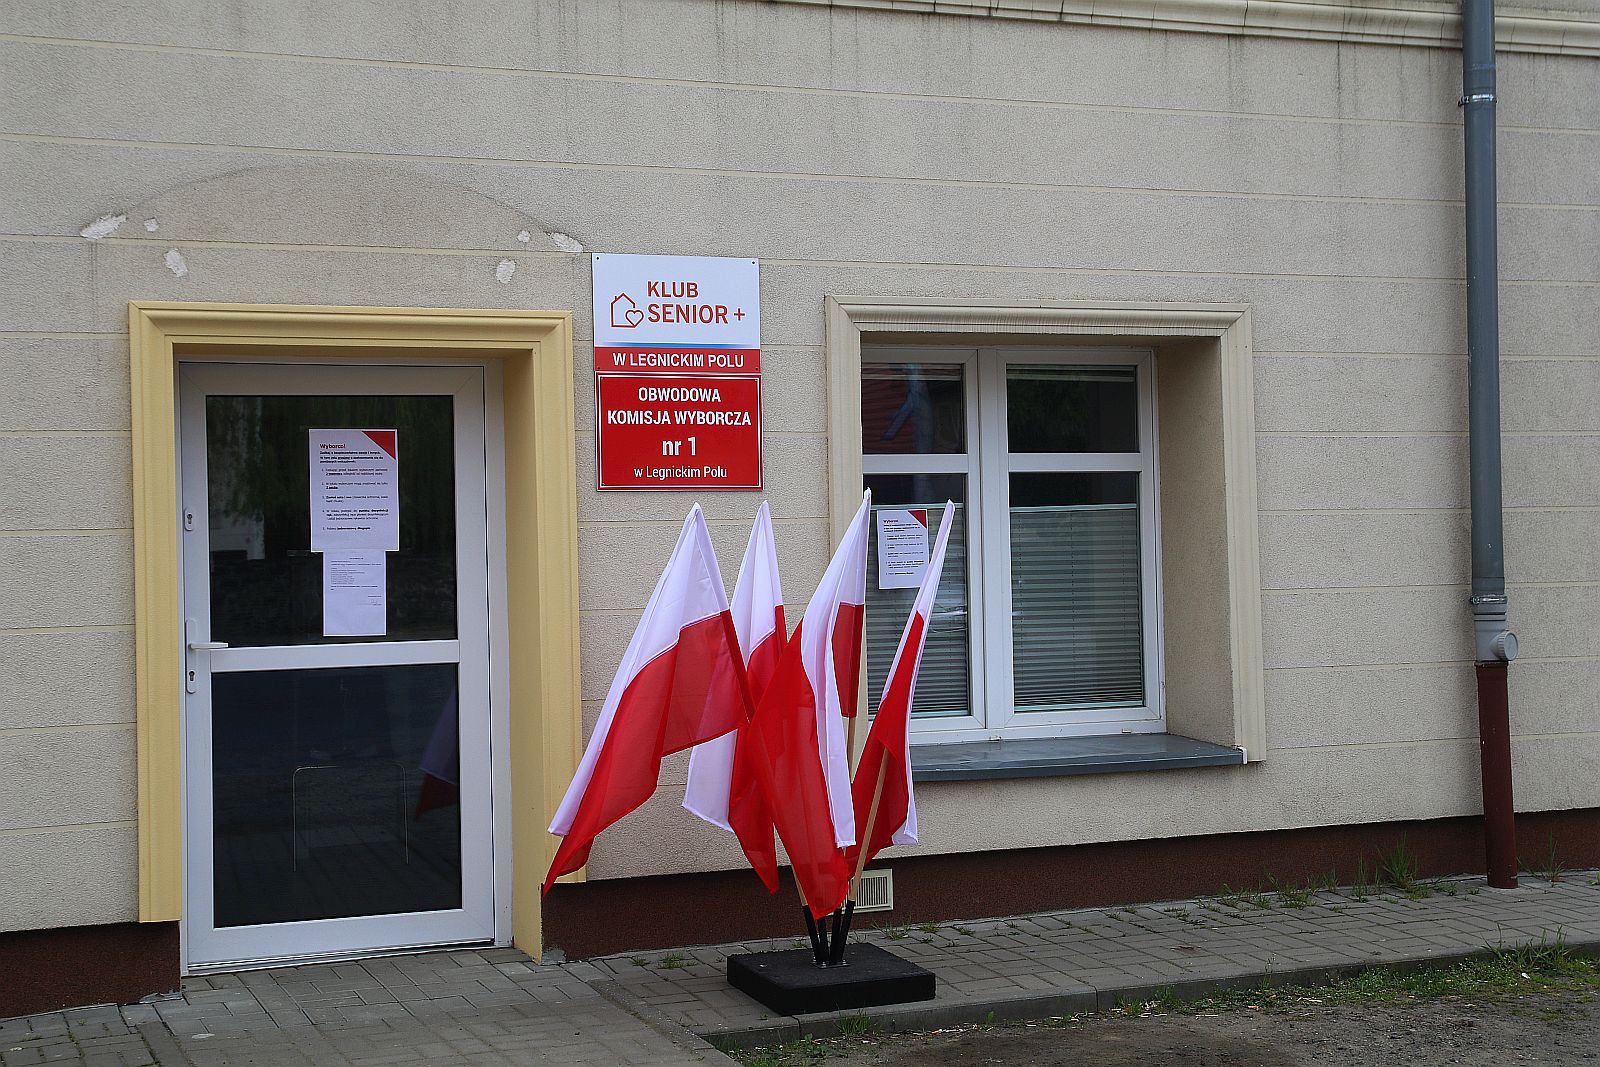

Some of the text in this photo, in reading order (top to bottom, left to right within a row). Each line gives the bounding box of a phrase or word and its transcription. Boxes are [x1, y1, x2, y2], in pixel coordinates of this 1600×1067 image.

[647, 280, 699, 298] KLUB
[647, 303, 745, 324] SENIOR +
[612, 352, 744, 368] W LEGNICKIM POLU
[638, 387, 721, 402] OBWODOWA
[607, 410, 752, 426] KOMISJA WYBORCZA
[662, 436, 696, 456] nr 1
[633, 465, 727, 480] w Legnickim Polu
